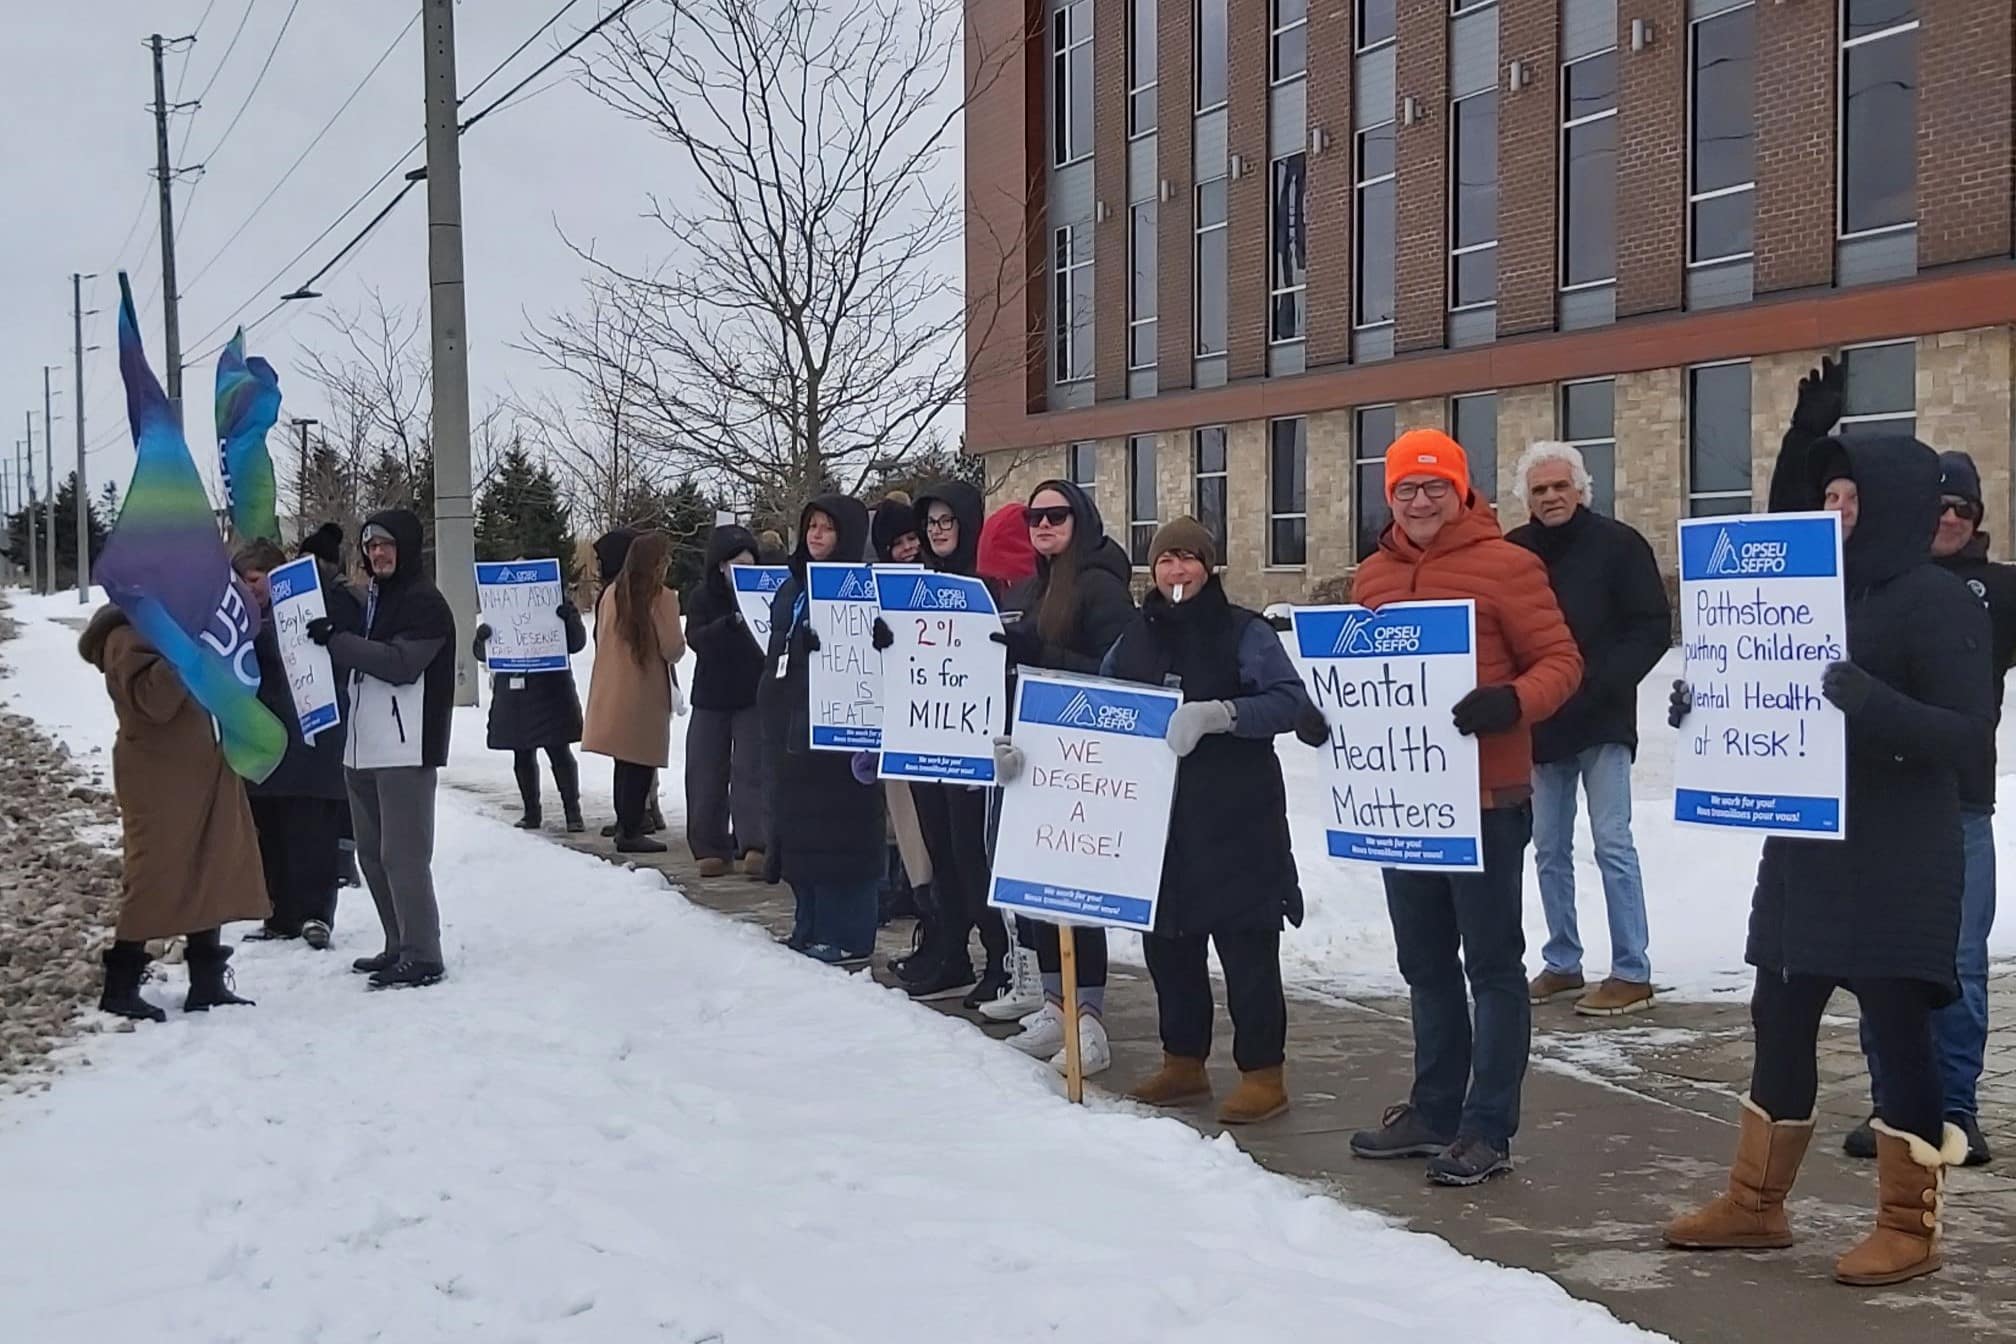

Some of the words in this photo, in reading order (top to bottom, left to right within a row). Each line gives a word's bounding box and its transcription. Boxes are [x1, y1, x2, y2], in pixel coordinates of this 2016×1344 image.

[1741, 542, 1786, 557] OPSEU
[1740, 558, 1786, 573] SEFPO
[937, 587, 966, 599] OPSEU
[938, 599, 967, 609] SEFPO
[1697, 587, 1814, 627] Pathstone
[915, 618, 962, 648] 2%
[1374, 625, 1421, 639] OPSEU
[1374, 639, 1420, 653] SEFPO
[1737, 633, 1841, 662] Children's
[909, 656, 927, 685] is
[938, 658, 969, 687] for
[1312, 661, 1428, 709] Mental
[856, 681, 873, 699] IS
[1744, 682, 1822, 711] Health
[1096, 716, 1136, 731] SEFPO
[1099, 704, 1140, 721] OPSEU
[1057, 736, 1104, 765] WE
[1328, 723, 1446, 773] Health
[1694, 725, 1711, 756] at
[1032, 766, 1138, 800] DESERVE
[1070, 801, 1085, 823] A
[1332, 784, 1456, 829] Matters
[1036, 823, 1123, 858] RAISE!
